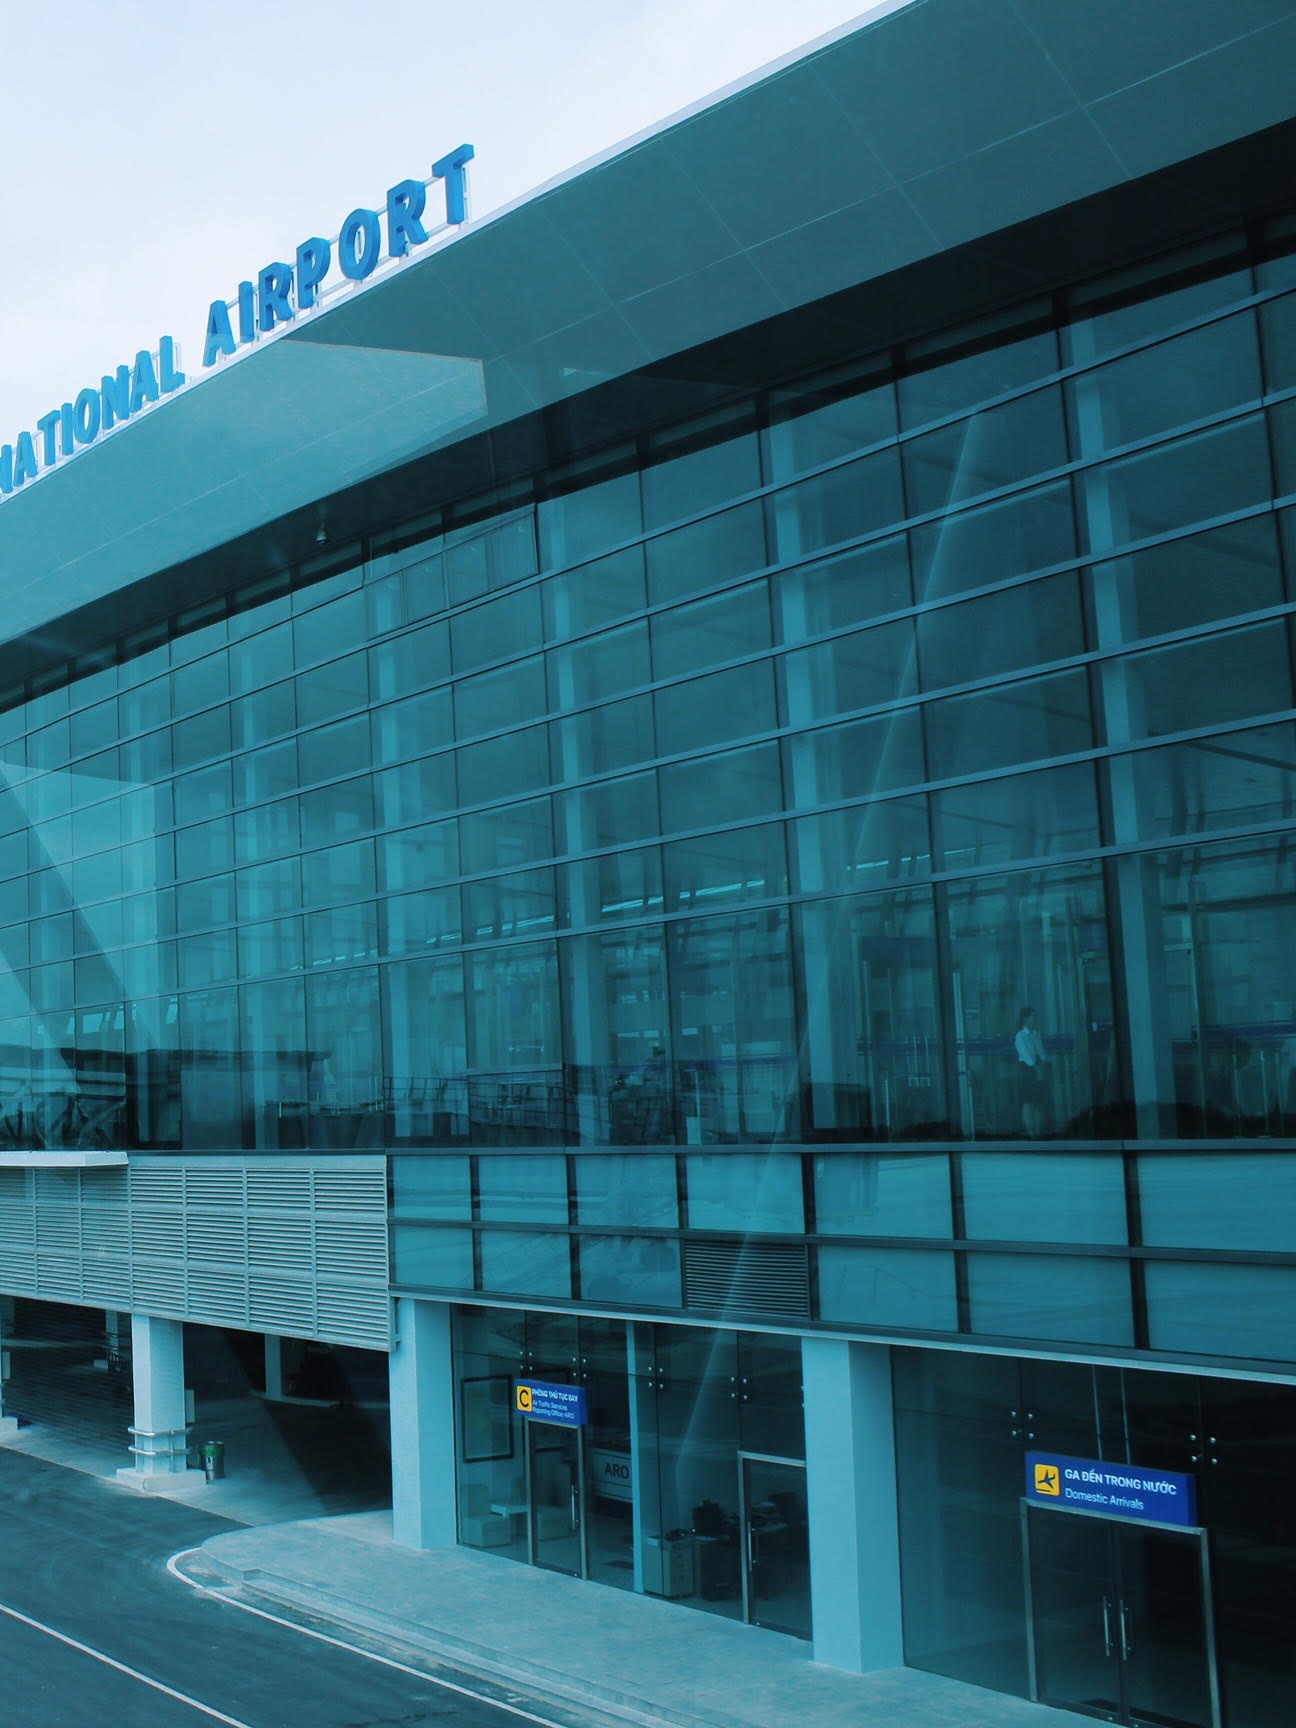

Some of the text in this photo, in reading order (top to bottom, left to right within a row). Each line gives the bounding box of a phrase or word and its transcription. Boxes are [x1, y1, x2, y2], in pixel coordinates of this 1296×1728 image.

[202, 143, 474, 367] AIRPORT
[604, 1462, 630, 1479] ARO
[1064, 1468, 1177, 1495] GA ĐẾN TRONG NƯỚC
[1064, 1487, 1144, 1510] Domestic Arrivals
